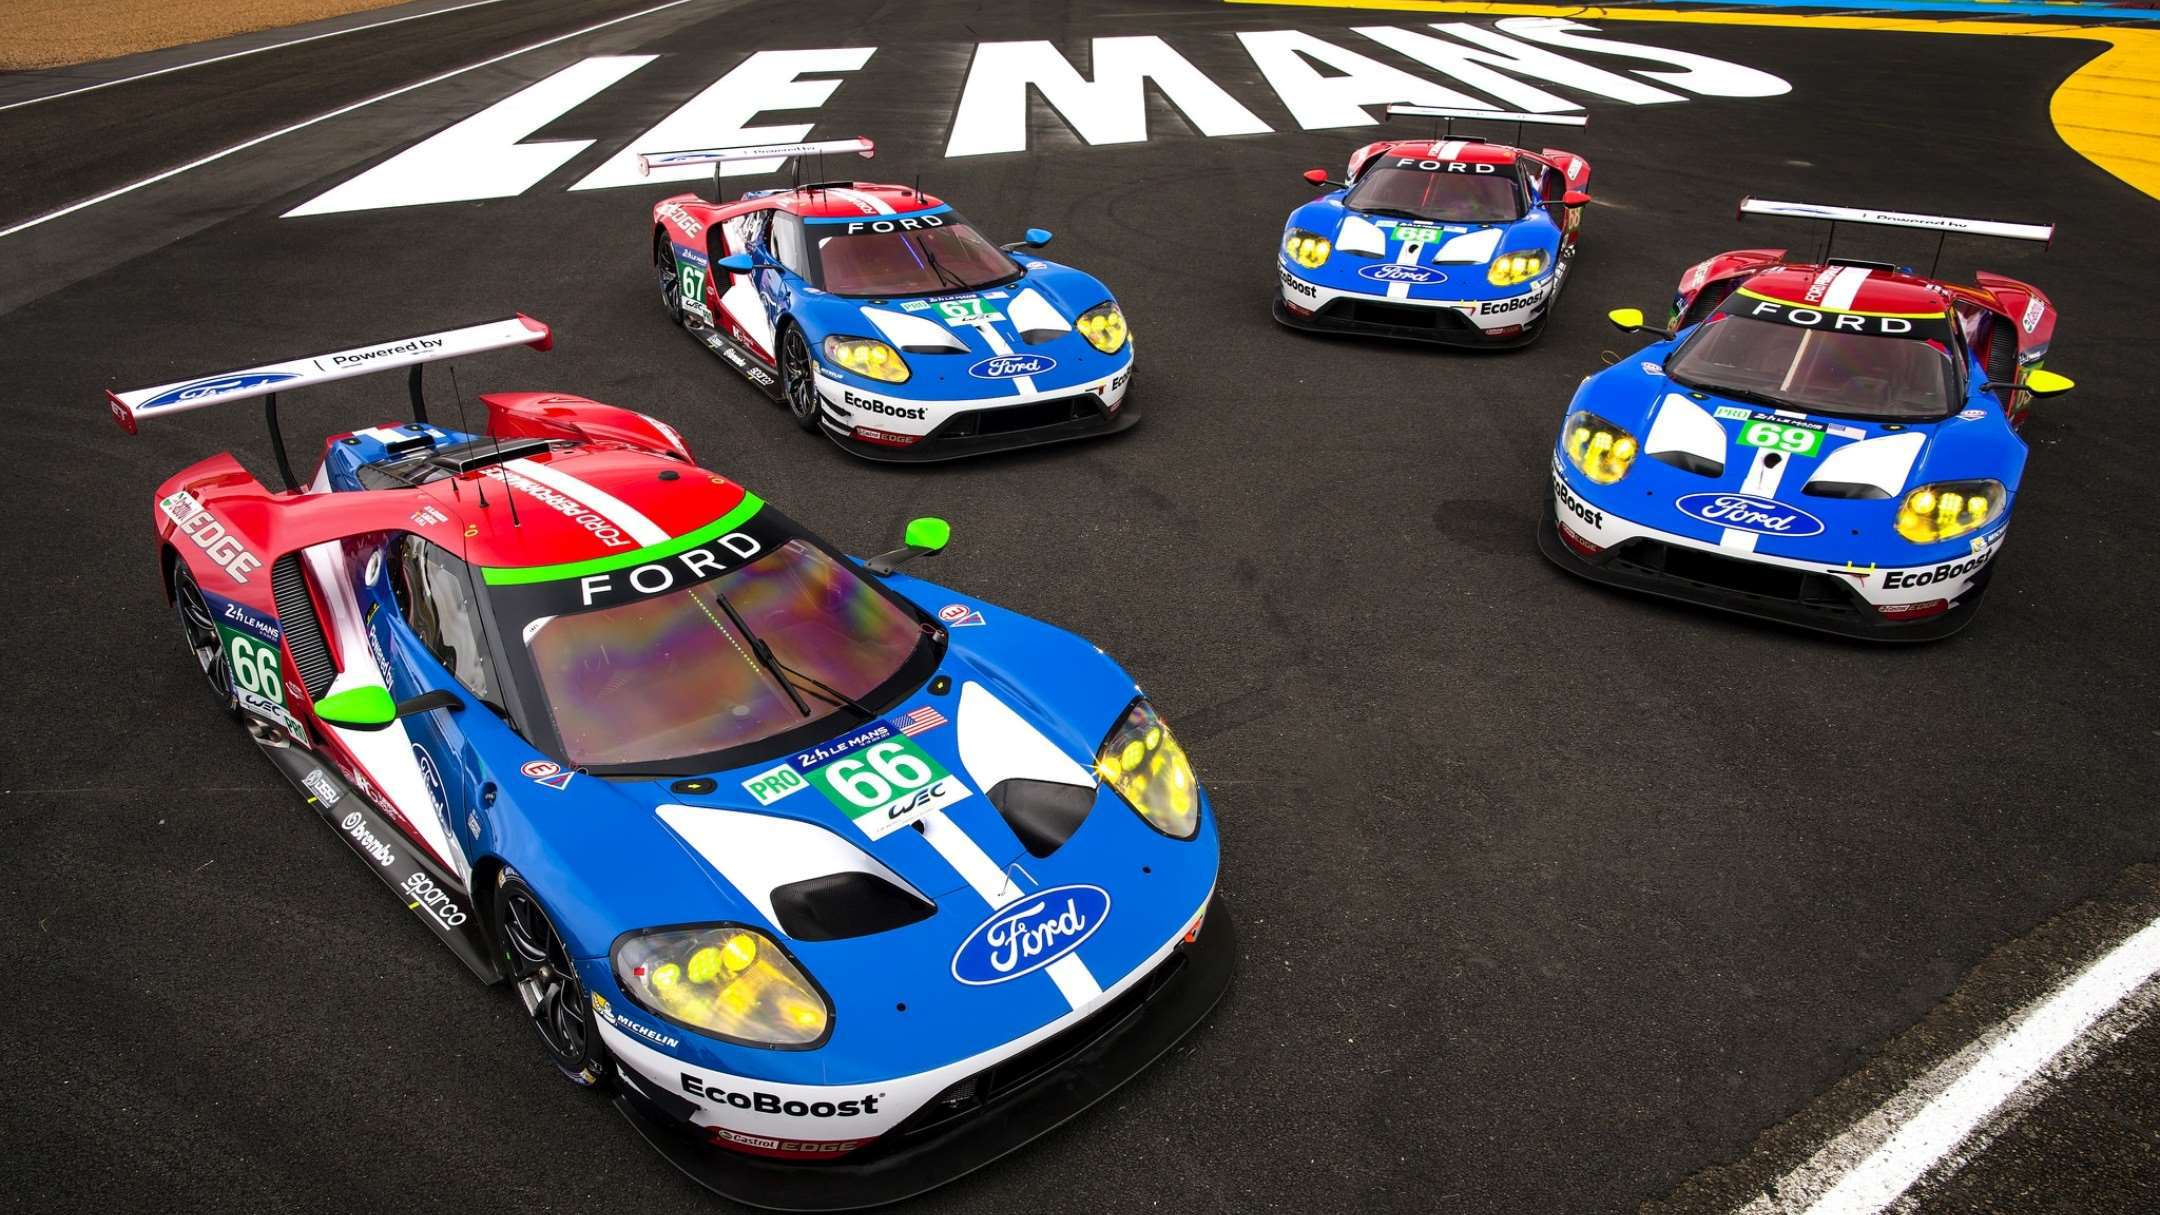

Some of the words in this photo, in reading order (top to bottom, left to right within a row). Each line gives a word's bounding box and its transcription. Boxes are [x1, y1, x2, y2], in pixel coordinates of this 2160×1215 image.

[280, 47, 878, 217] LE
[944, 17, 1793, 158] MANS
[1396, 158, 1496, 173] FORD
[847, 215, 944, 235] FORD
[682, 266, 705, 301] 67
[1374, 265, 1431, 281] Ford
[940, 299, 984, 320] 67
[1480, 290, 1544, 315] EcoBoost
[1751, 302, 1912, 333] FORD
[333, 341, 417, 366] Powered
[420, 336, 443, 349] by
[988, 357, 1041, 376] Ford
[844, 391, 926, 420] EcoBoost
[1746, 422, 1816, 453] 69
[1701, 496, 1797, 530] Ford
[576, 513, 631, 547] FORD
[181, 511, 262, 584] EDGE
[580, 532, 762, 606] FORD
[1882, 547, 1993, 590] EcoBoost
[244, 616, 255, 628] LE
[255, 621, 280, 638] MANS
[231, 636, 283, 705] 66
[245, 694, 281, 716] WEC
[829, 742, 849, 756] LE
[848, 726, 889, 747] MANS
[748, 768, 801, 801] PRO
[825, 742, 933, 808] 66
[888, 781, 946, 820] WEC
[350, 820, 395, 867] brembo
[406, 872, 467, 926] sparco
[986, 898, 1086, 972] Ford
[617, 1013, 680, 1048] MICHELIN
[681, 1072, 879, 1118] EcoBoost
[733, 1134, 775, 1149] Castrol
[780, 1140, 859, 1152] EDGE
